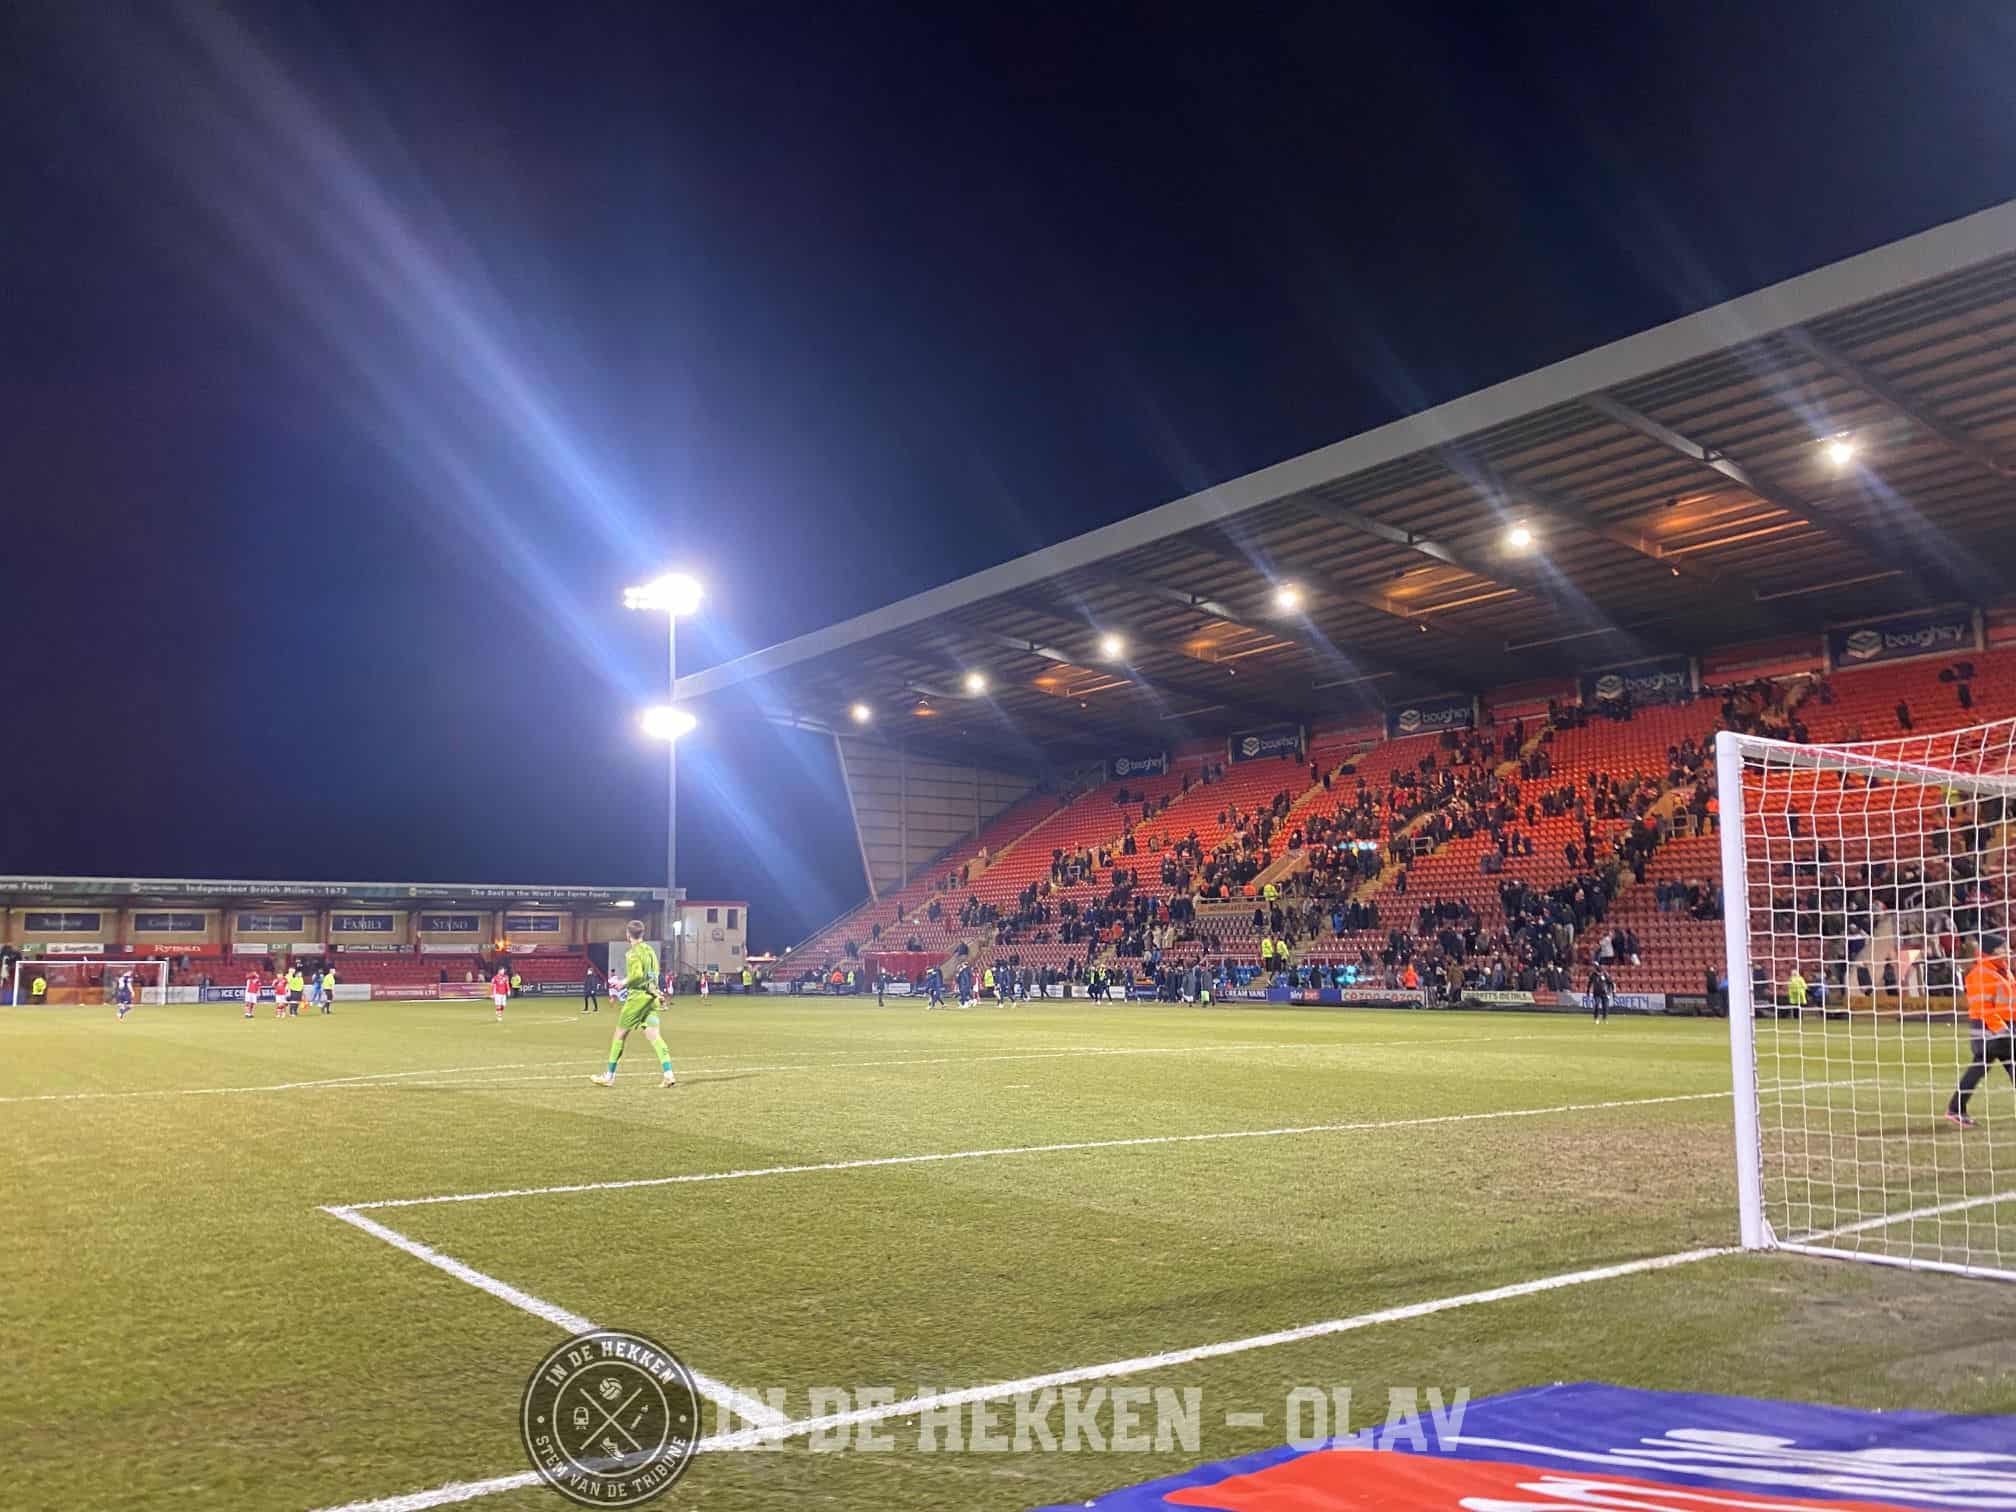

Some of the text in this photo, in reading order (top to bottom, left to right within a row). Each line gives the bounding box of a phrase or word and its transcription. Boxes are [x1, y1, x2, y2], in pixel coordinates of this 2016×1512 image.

[1884, 623, 1965, 647] boughey
[343, 918, 384, 930] FAMILY
[432, 918, 469, 930] STAND
[1290, 989, 1303, 1000] sky
